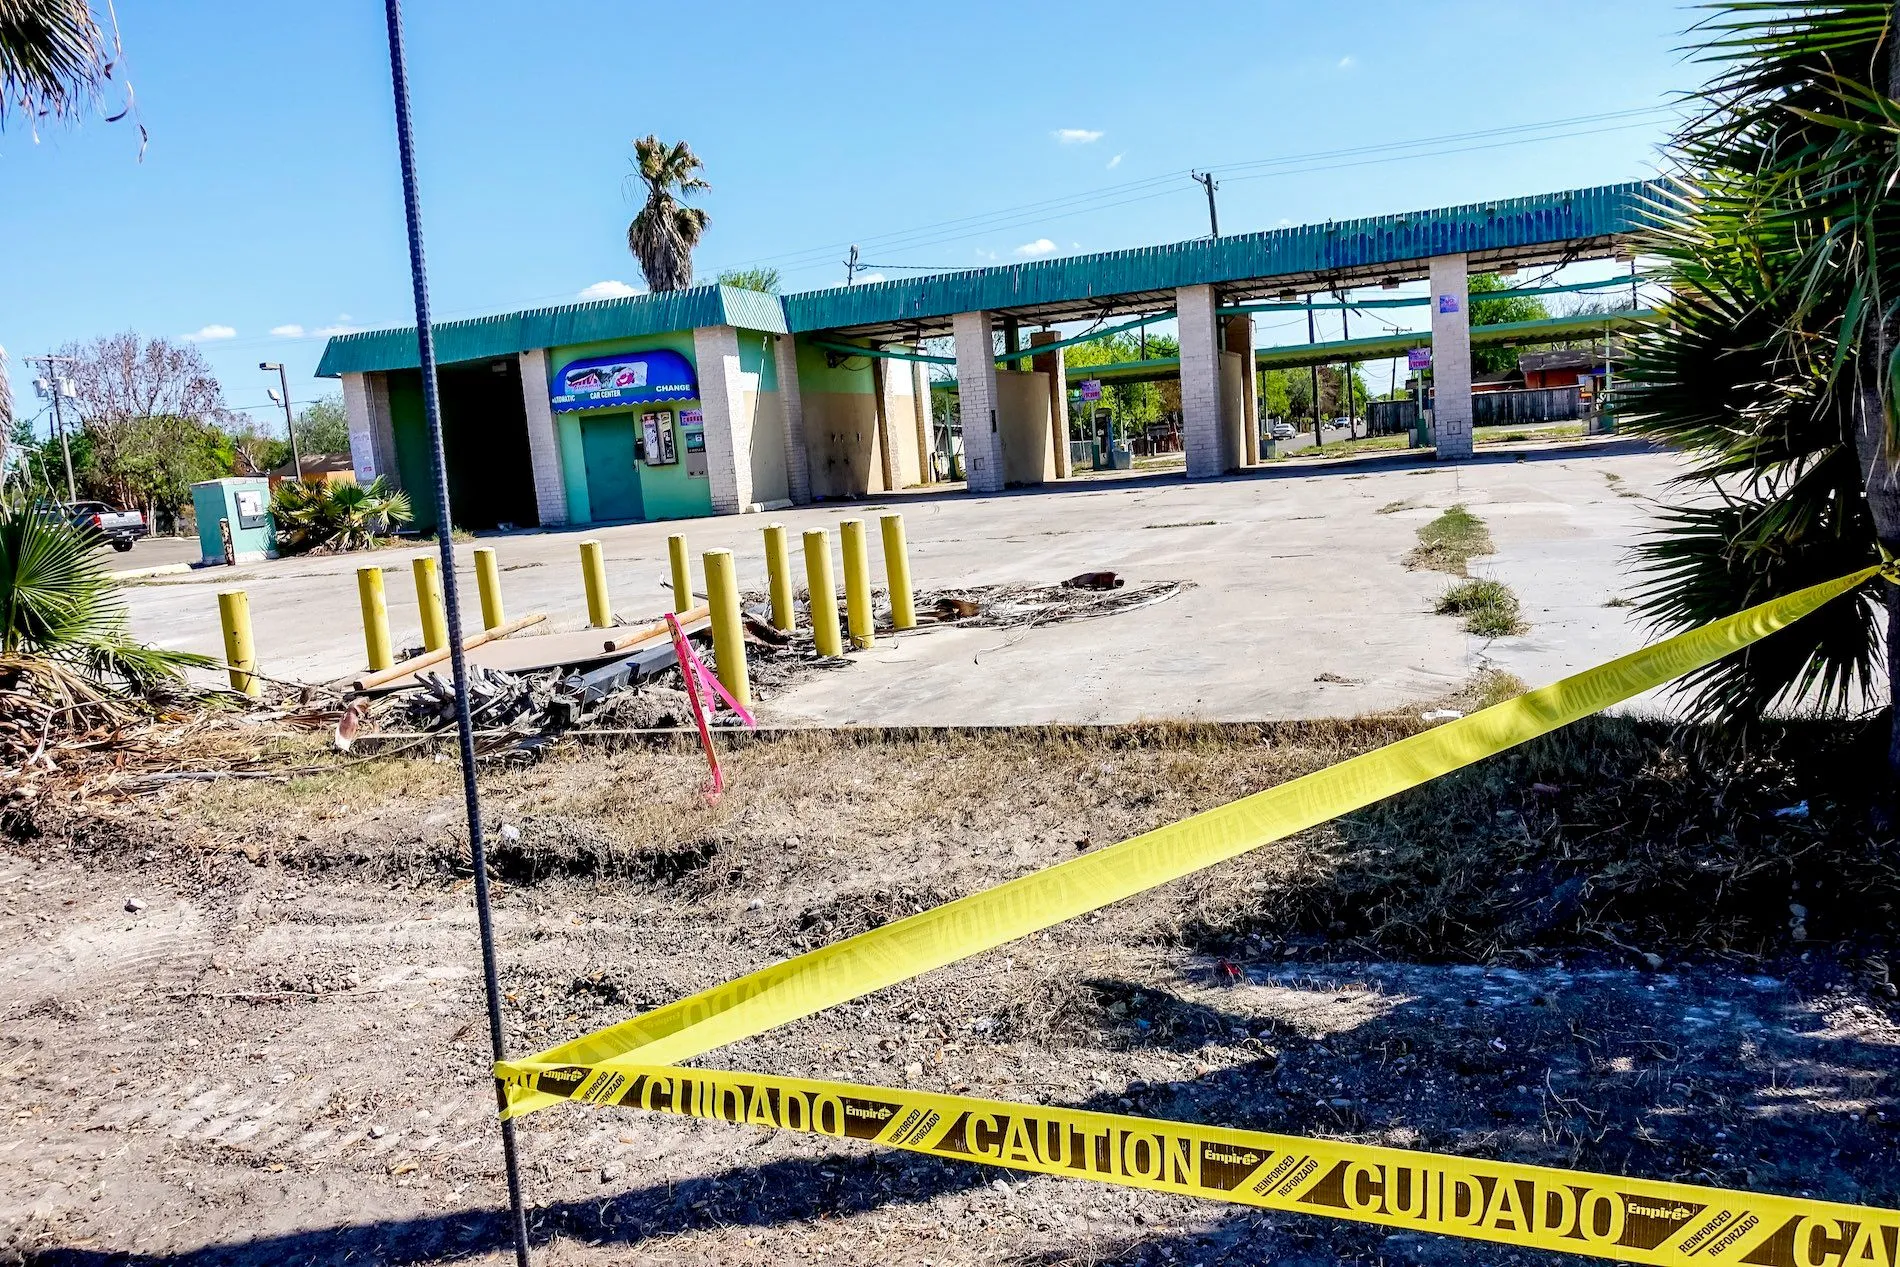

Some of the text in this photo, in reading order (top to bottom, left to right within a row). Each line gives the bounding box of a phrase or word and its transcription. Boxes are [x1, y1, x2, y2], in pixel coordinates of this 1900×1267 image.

[589, 390, 621, 400] CAR CENTER
[655, 384, 691, 392] CHANGE
[542, 1070, 583, 1082] Empire
[641, 1075, 846, 1137] CUIDADO
[846, 1105, 886, 1120] Empire
[890, 1109, 921, 1143] EINFORCED
[908, 1113, 941, 1146] EFORZADO
[965, 1111, 1201, 1190] CAUTION
[1204, 1149, 1252, 1166] Empire
[1252, 1155, 1295, 1194] REINFORCED
[1277, 1159, 1319, 1197] REFORZADO
[1343, 1161, 1626, 1245] CUIDADO
[1628, 1202, 1682, 1221] Empire
[1679, 1209, 1732, 1254] REINFORCED
[1707, 1215, 1760, 1257] REFORZADO
